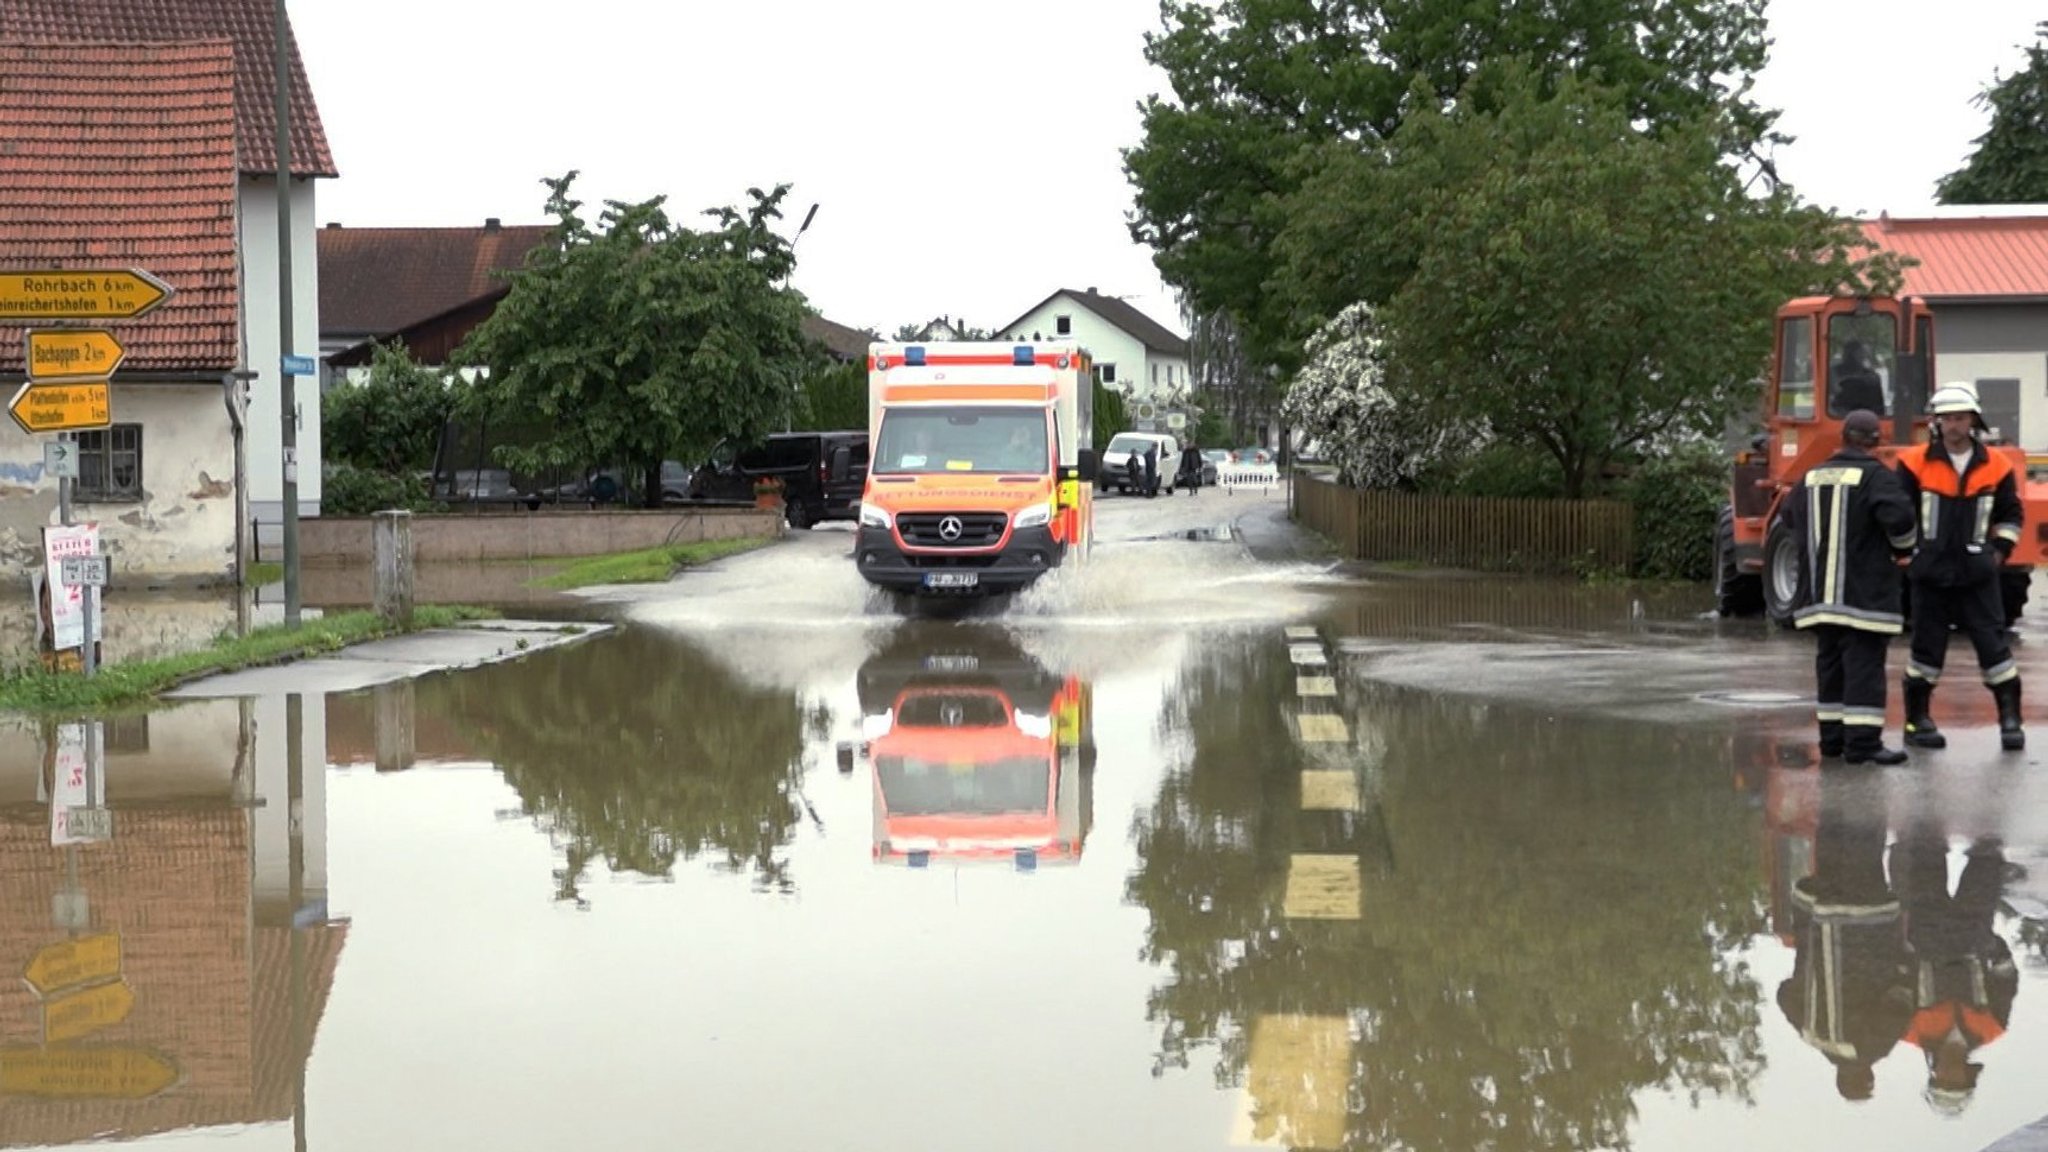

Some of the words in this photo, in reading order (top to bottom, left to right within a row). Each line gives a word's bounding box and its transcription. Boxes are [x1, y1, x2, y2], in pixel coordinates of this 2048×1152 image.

[23, 277, 97, 292] Rohrbach
[103, 278, 112, 292] 6
[115, 280, 134, 292] km
[108, 297, 113, 311] 1
[117, 300, 135, 311] km
[84, 342, 91, 361] 2
[93, 346, 106, 360] km
